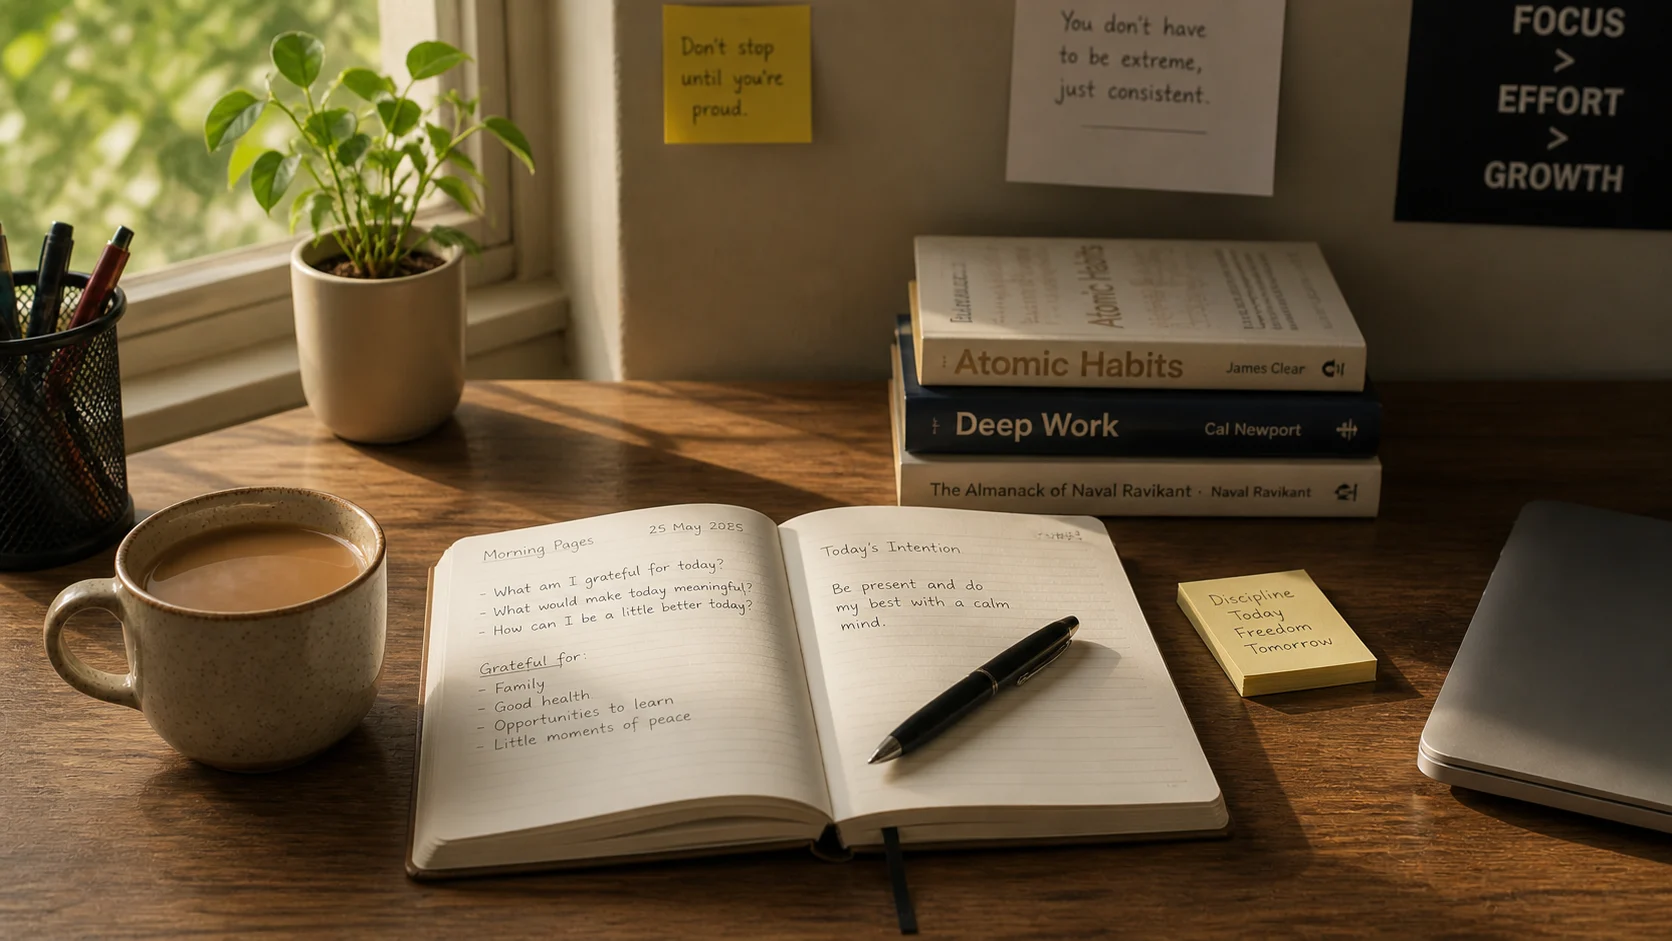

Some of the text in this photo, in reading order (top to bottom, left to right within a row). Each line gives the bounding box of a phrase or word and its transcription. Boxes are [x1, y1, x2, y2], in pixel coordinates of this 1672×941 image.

[1060, 9, 1207, 38] You don't have
[1513, 5, 1626, 37] FOCUS
[681, 36, 774, 62] Don't stop
[1060, 46, 1202, 74] to be extreme,
[681, 68, 784, 94] until you're
[1054, 78, 1210, 105] just consistent.
[692, 99, 747, 126] proud.
[1497, 84, 1625, 116] EFFORT
[1484, 161, 1624, 193] GROWTH
[1081, 283, 1124, 329] Atomic
[954, 349, 1306, 378] Atomic Habits James Clear
[956, 411, 1302, 442] Deep Work Cal Newport
[930, 482, 1312, 498] The Almanack of Naval Ravikant Naval Ravikant
[649, 523, 666, 534] 25
[673, 522, 701, 536] May
[483, 537, 594, 561] Morning Pages
[821, 541, 961, 559] Today's Intention
[493, 558, 724, 598] What am I grateful for today?
[832, 578, 984, 595] Be present and do
[493, 581, 752, 617] What would make today meaningful?
[836, 596, 1010, 617] my best with a calm
[1208, 588, 1295, 606] Discipline
[493, 599, 753, 637] How can I be a little better today?
[840, 617, 886, 631] mind.
[1227, 608, 1285, 622] Today
[1234, 623, 1312, 638] Freedom
[1244, 637, 1333, 655] Tomorrow
[479, 652, 587, 676] Grateful for:
[495, 678, 546, 694] Family
[494, 698, 532, 713] Good
[494, 695, 674, 735] Opportunities to learn
[494, 711, 691, 750] Little moments of peace
